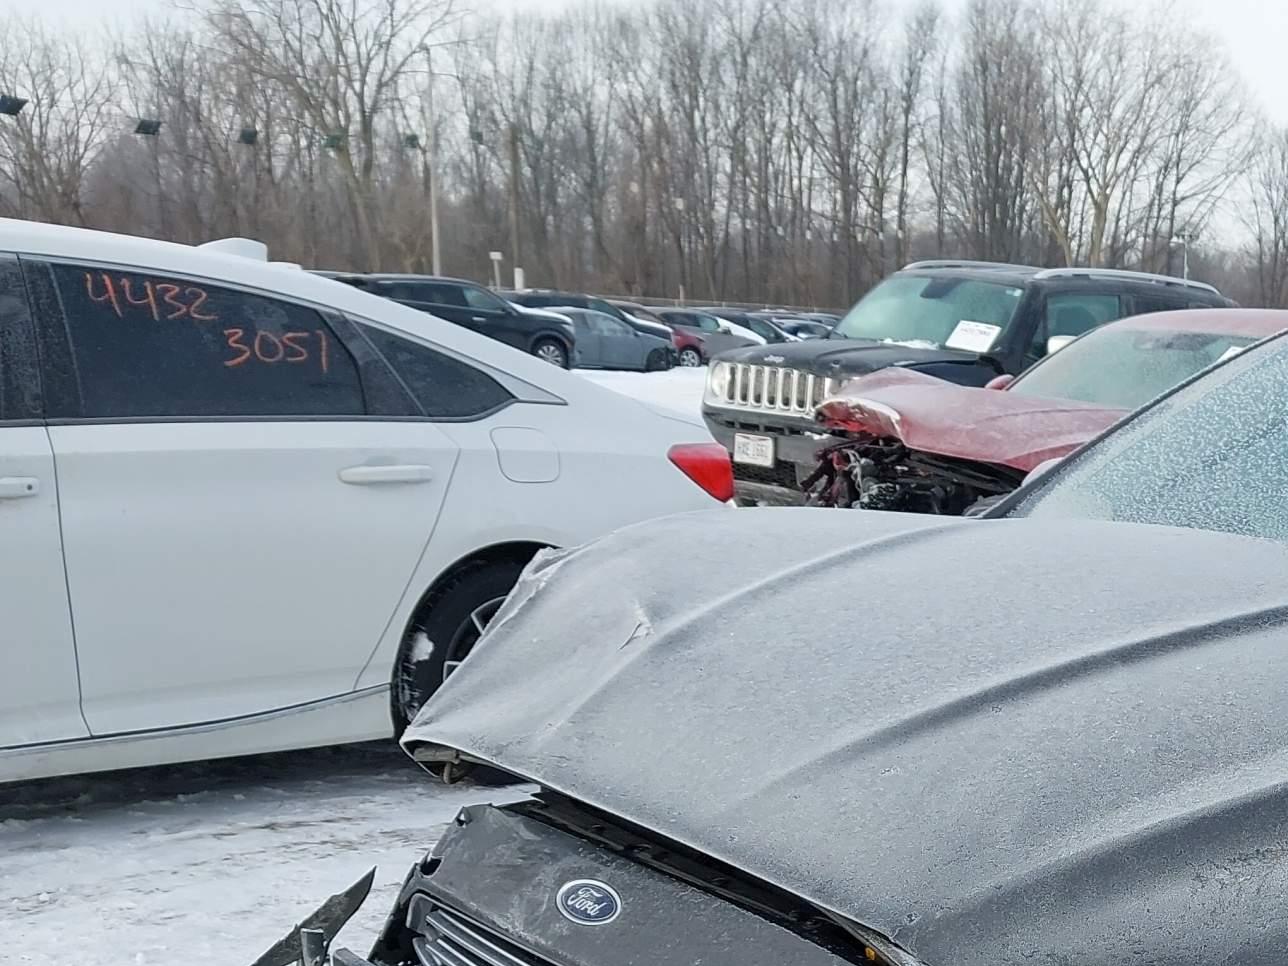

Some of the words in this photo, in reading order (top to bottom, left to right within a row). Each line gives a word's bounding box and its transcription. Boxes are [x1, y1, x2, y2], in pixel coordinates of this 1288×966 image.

[84, 271, 218, 320] 4432
[223, 329, 328, 373] 3051
[567, 886, 607, 916] Ford
